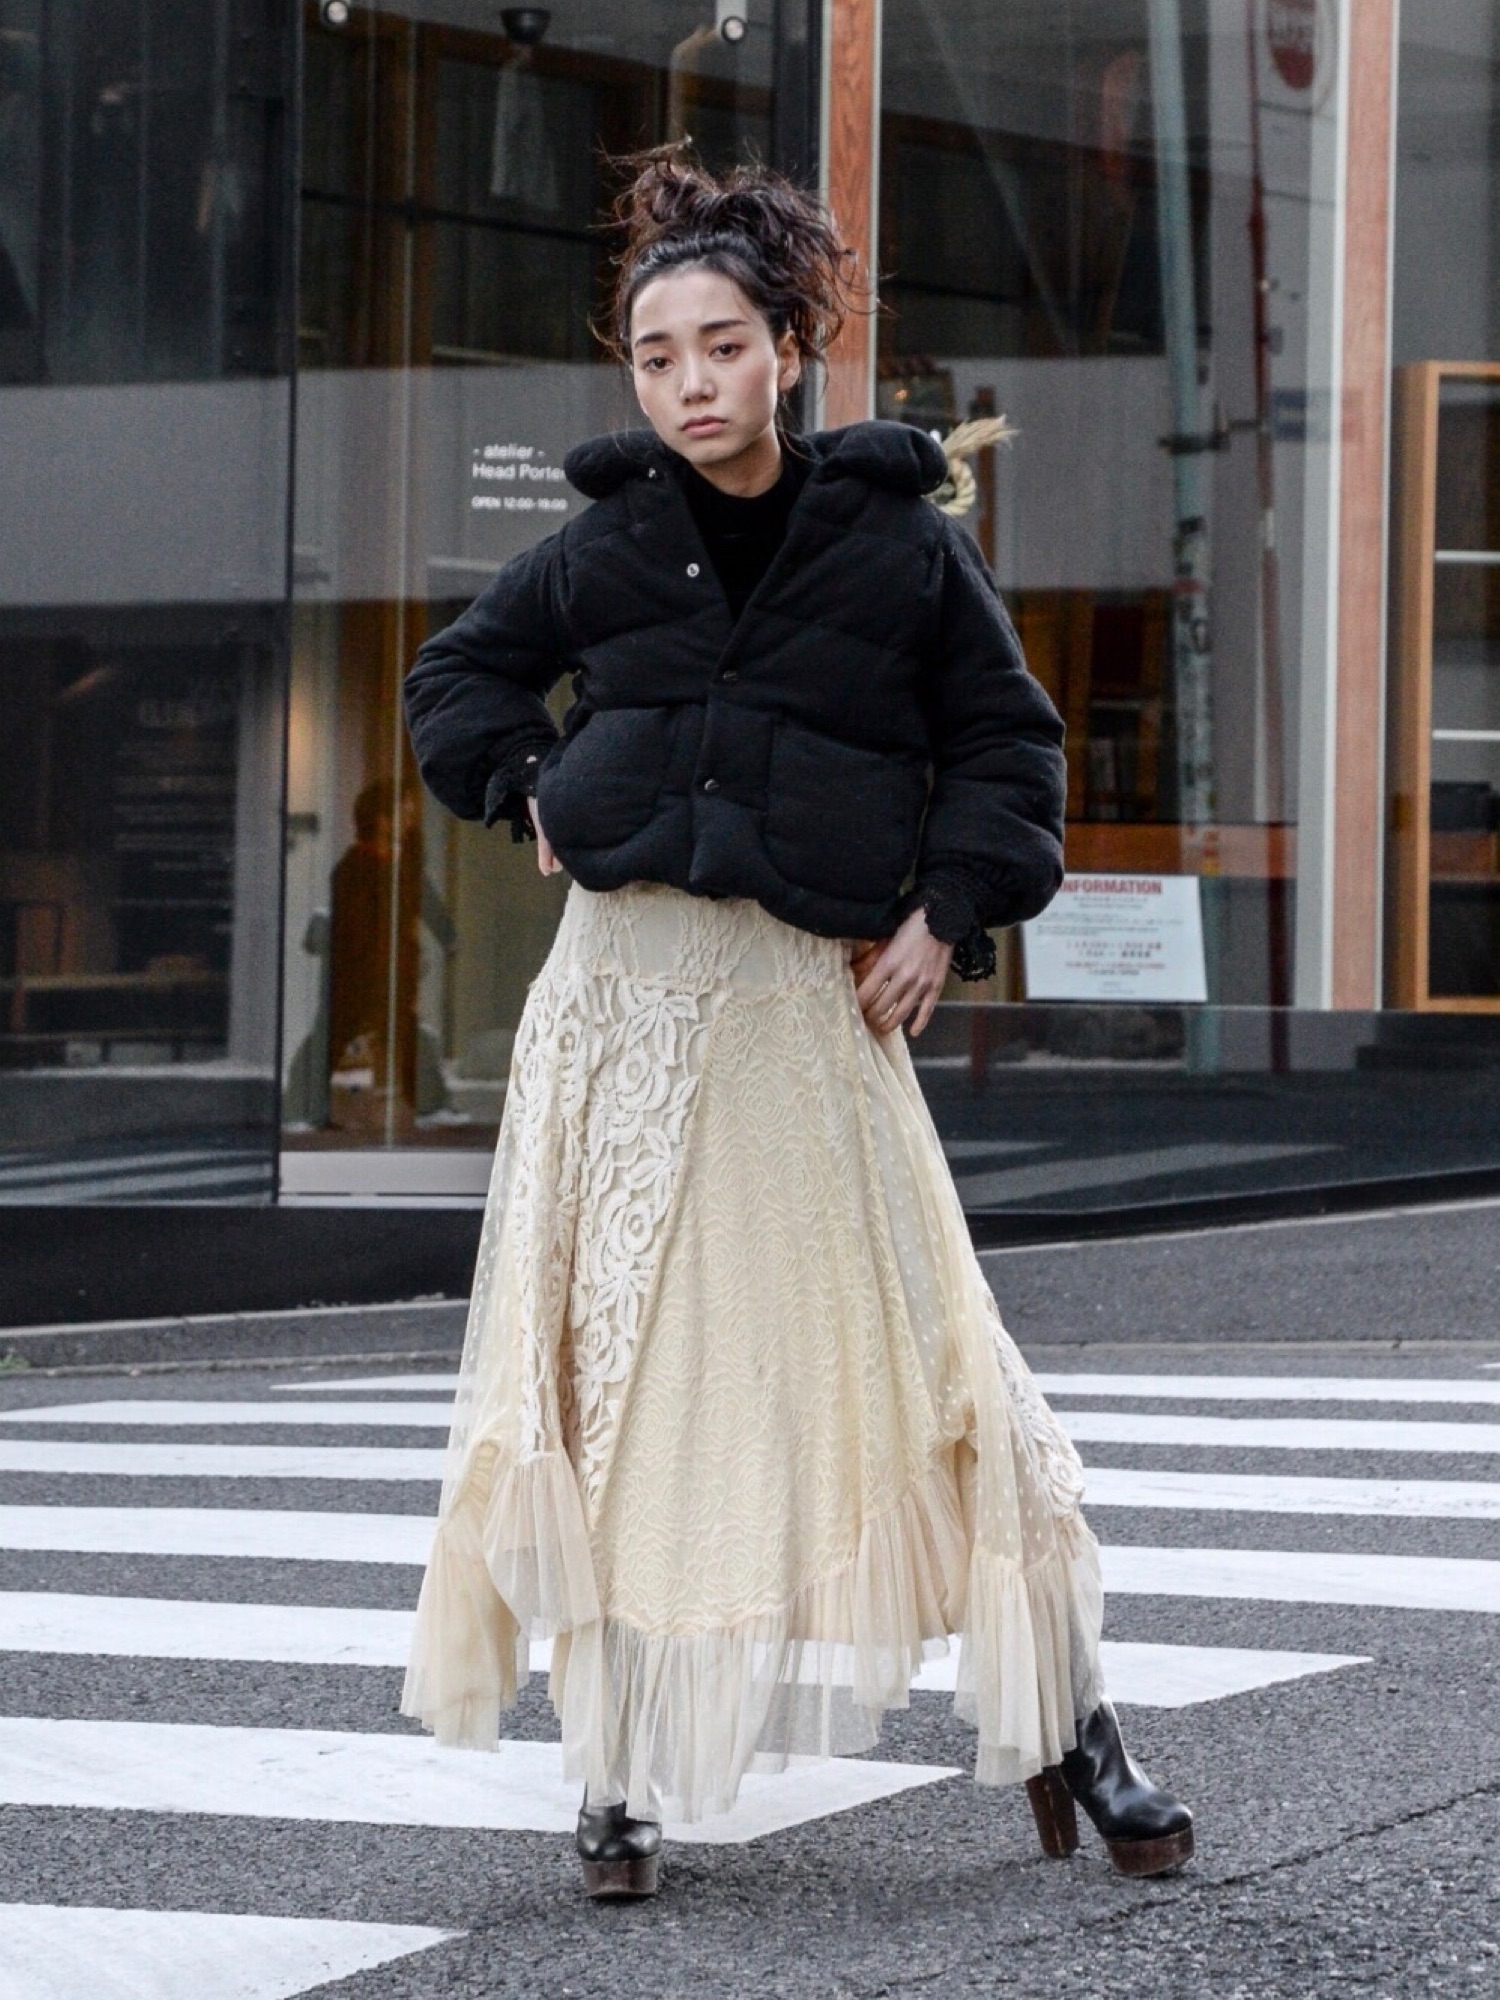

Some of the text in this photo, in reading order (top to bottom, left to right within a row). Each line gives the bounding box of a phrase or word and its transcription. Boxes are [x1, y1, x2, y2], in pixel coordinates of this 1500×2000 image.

[484, 443, 533, 459] atelier
[472, 462, 515, 479] Head
[471, 496, 501, 509] OPEN
